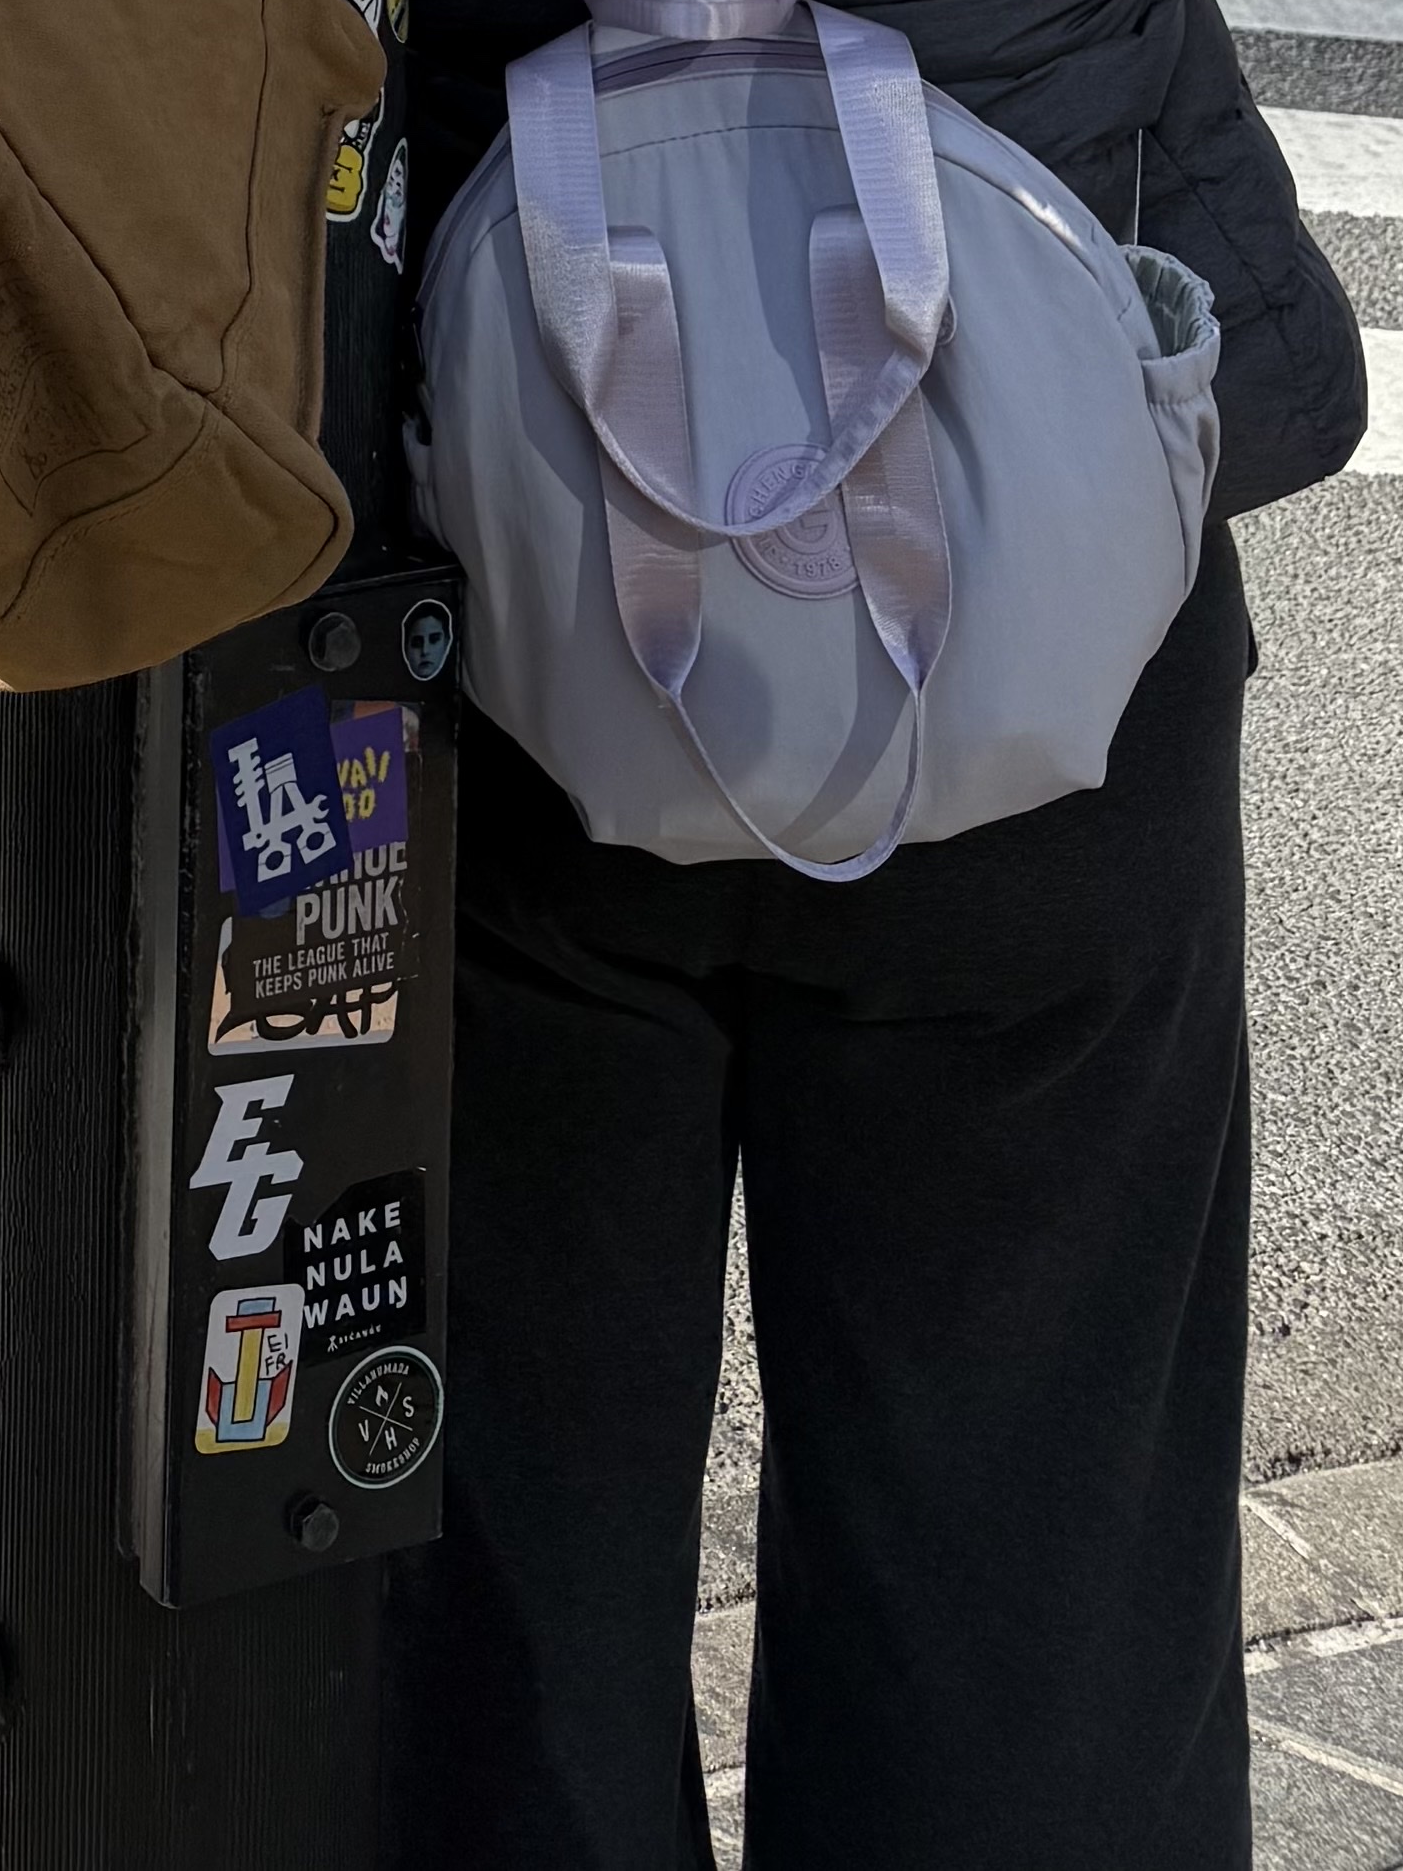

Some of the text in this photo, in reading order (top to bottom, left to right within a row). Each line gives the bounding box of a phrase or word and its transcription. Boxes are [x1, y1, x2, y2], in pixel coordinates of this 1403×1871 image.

[296, 876, 398, 945] PUNK
[252, 932, 390, 978] THE LEAGUE THAT
[255, 950, 395, 999] KEEPS PUNK ALIVE
[303, 1200, 402, 1253] NAKE
[306, 1240, 404, 1291] NULA
